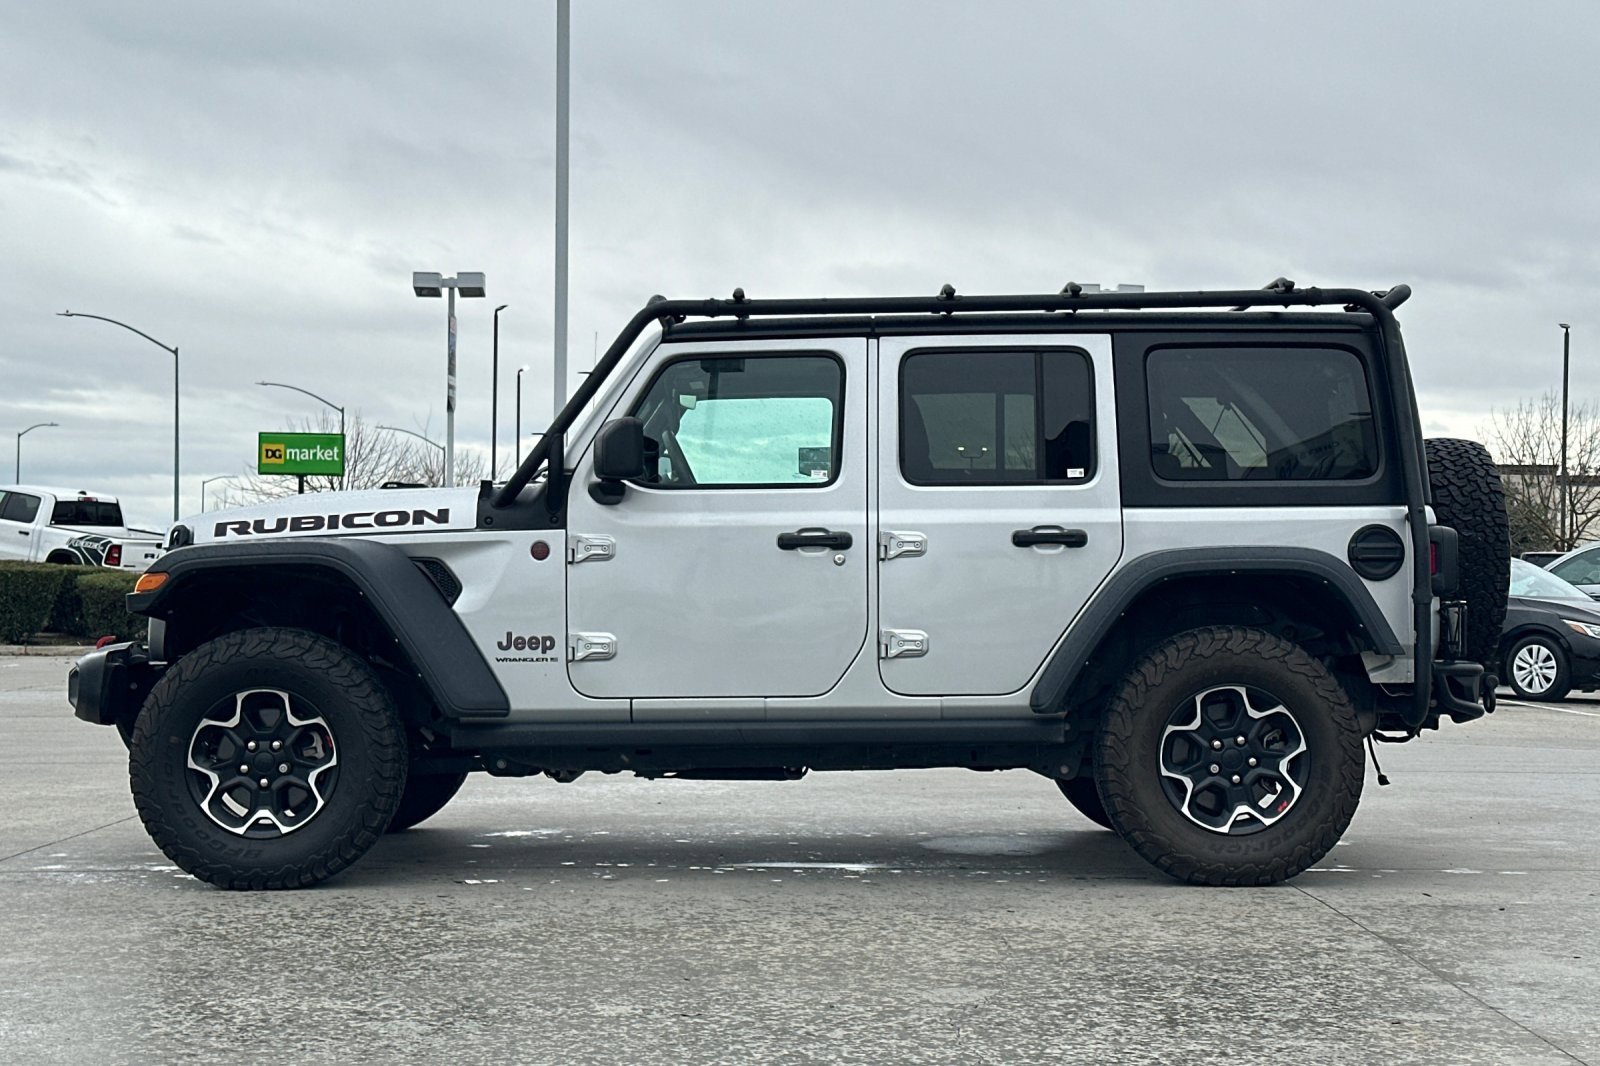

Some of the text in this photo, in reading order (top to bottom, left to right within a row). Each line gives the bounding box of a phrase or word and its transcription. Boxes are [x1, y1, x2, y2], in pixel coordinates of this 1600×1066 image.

[265, 445, 340, 461] DG market
[213, 508, 450, 538] RUBICON
[497, 631, 556, 654] Jeep
